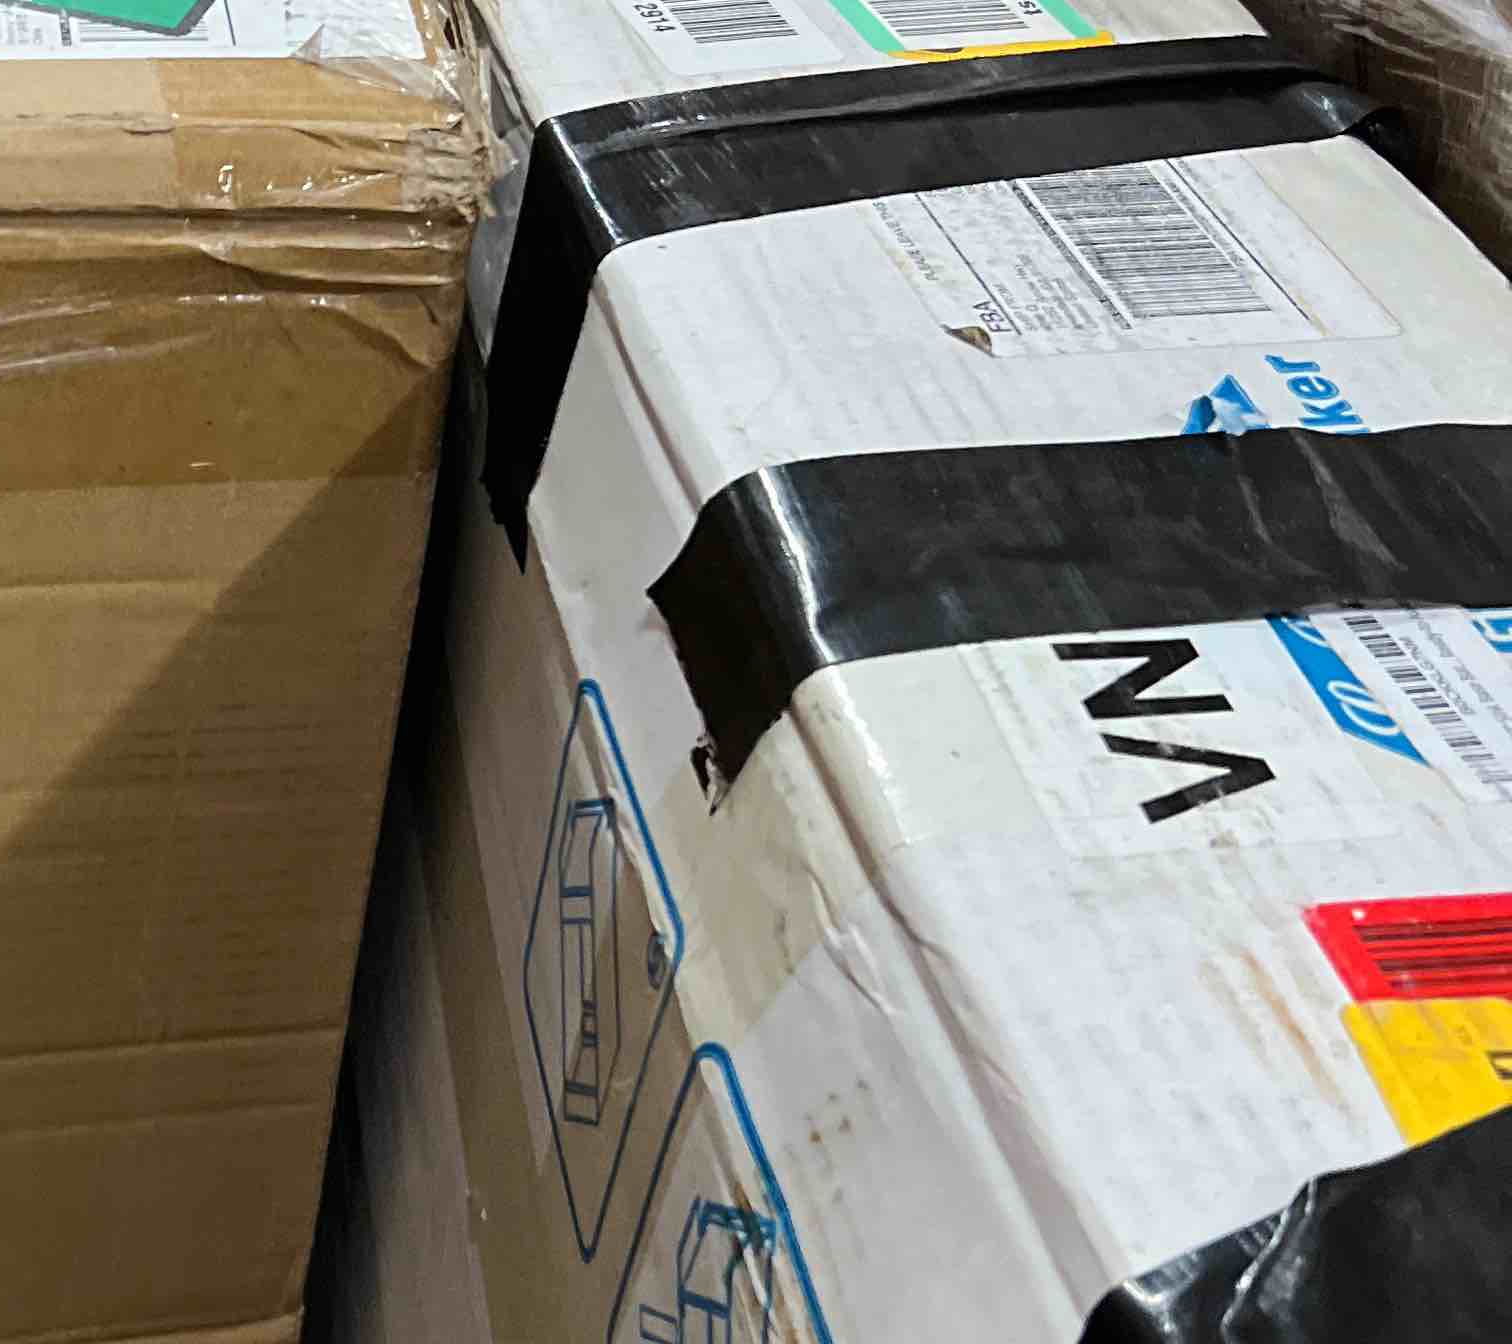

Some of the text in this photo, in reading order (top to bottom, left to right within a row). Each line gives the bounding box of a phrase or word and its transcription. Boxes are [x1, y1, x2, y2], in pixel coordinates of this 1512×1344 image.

[634, 2, 676, 33] 2914
[972, 300, 1012, 333] FBA
[1264, 354, 1371, 434] ker
